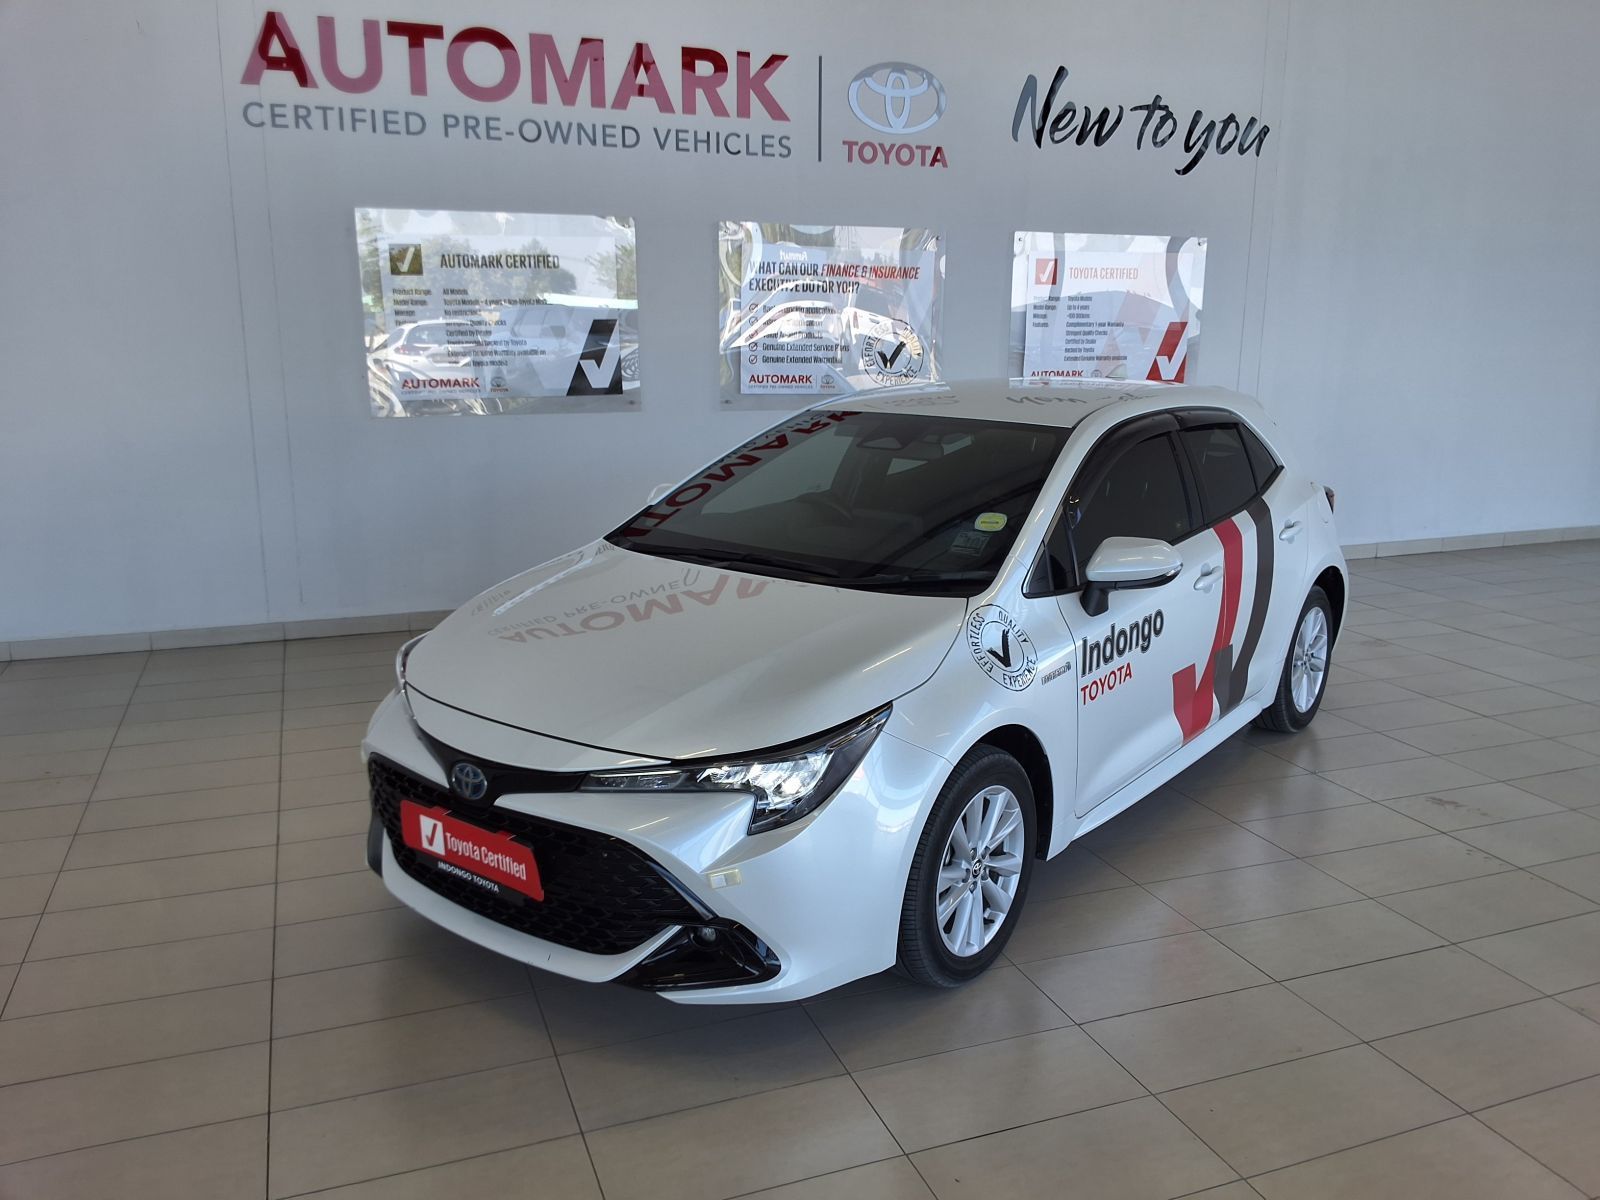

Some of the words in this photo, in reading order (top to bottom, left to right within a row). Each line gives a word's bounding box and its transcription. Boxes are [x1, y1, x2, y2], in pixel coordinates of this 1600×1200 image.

[240, 11, 791, 122] AUTOMARK
[242, 102, 427, 136] CERTIFIED
[443, 113, 641, 149] PRE-OWNED
[653, 127, 792, 158] VEHICLES
[1011, 65, 1124, 150] New
[1130, 94, 1178, 150] to
[1174, 109, 1270, 176] you
[842, 140, 948, 168] TOYOTA
[440, 254, 503, 269] AUTOMARK
[505, 254, 560, 269] CERTIFIED
[779, 262, 798, 276] CAN
[800, 263, 818, 277] OUR
[821, 264, 860, 278] FINANCE
[869, 265, 920, 280] INSURANCE
[1069, 267, 1098, 280] TOYOTA
[1100, 267, 1139, 280] CERTIFIED
[836, 280, 860, 295] YOU?
[786, 342, 812, 352] Extended
[813, 342, 833, 352] Service
[786, 354, 812, 364] Extended
[402, 377, 480, 389] AUTOMARK
[749, 374, 812, 384] AUTOMARK
[875, 366, 918, 386] EXPERIENCE
[998, 611, 1029, 645] QUALITY
[969, 612, 994, 674] EFFORTLESS
[1081, 608, 1165, 679] Indongo
[1003, 655, 1037, 686] EXPERIENCE
[1081, 662, 1133, 706] TOYOTA
[445, 832, 480, 861] Toyota
[481, 846, 527, 881] Certified
[437, 861, 472, 881] INDONGO
[473, 874, 500, 894] TOYOTA
